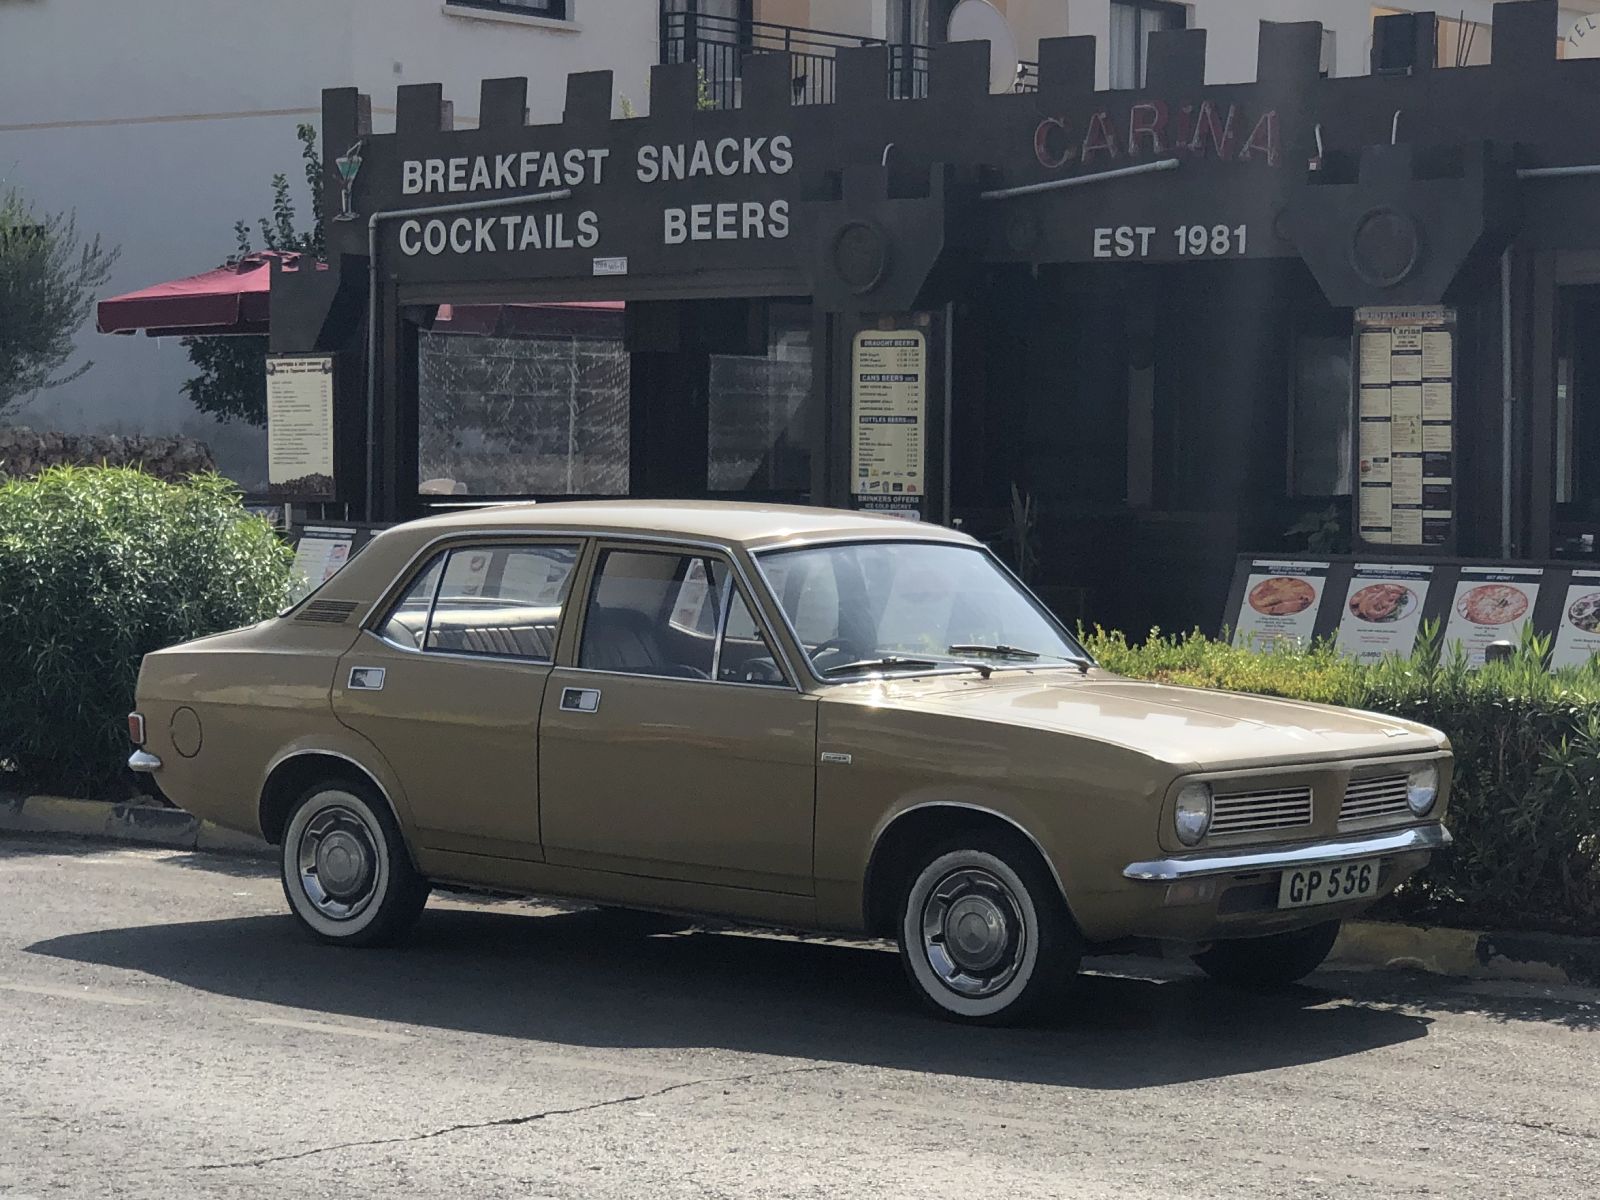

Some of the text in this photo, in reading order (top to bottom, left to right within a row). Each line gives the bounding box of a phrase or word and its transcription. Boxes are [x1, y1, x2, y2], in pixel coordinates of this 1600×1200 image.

[402, 135, 793, 194] BREAKFAST SNACKS
[399, 200, 789, 256] COCKTAILS BEERS
[1093, 224, 1247, 257] EST 1981
[1289, 864, 1372, 902] GP 556
